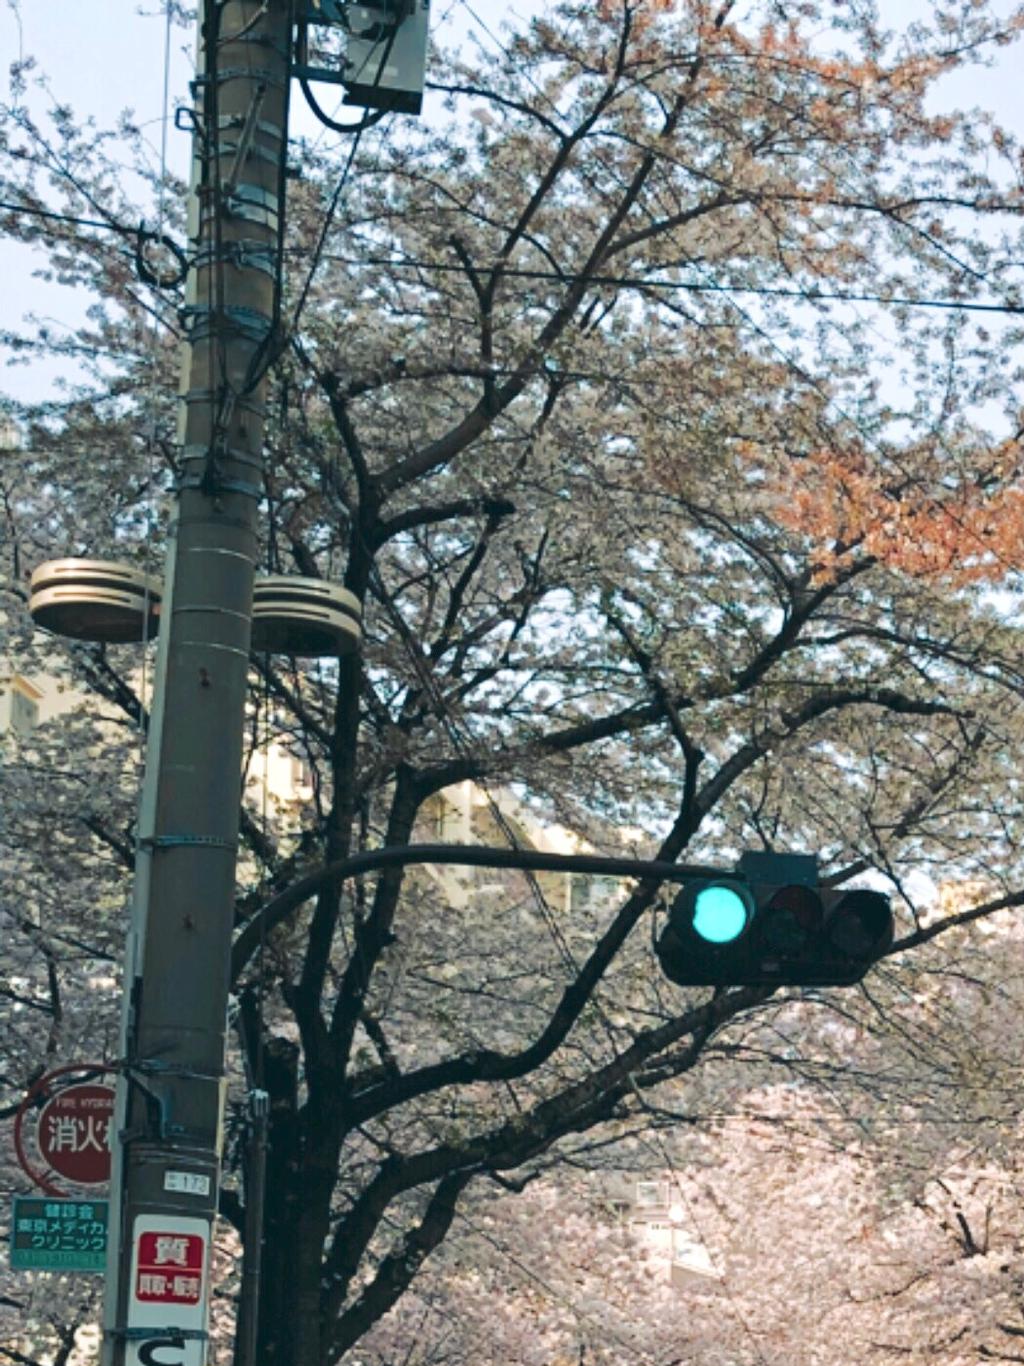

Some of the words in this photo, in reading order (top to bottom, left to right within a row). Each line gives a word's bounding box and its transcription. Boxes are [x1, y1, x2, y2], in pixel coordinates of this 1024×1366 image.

[17, 1219, 109, 1235] 東京メディカ
[31, 1235, 105, 1250] クリニック
[154, 1236, 190, 1266] 質
